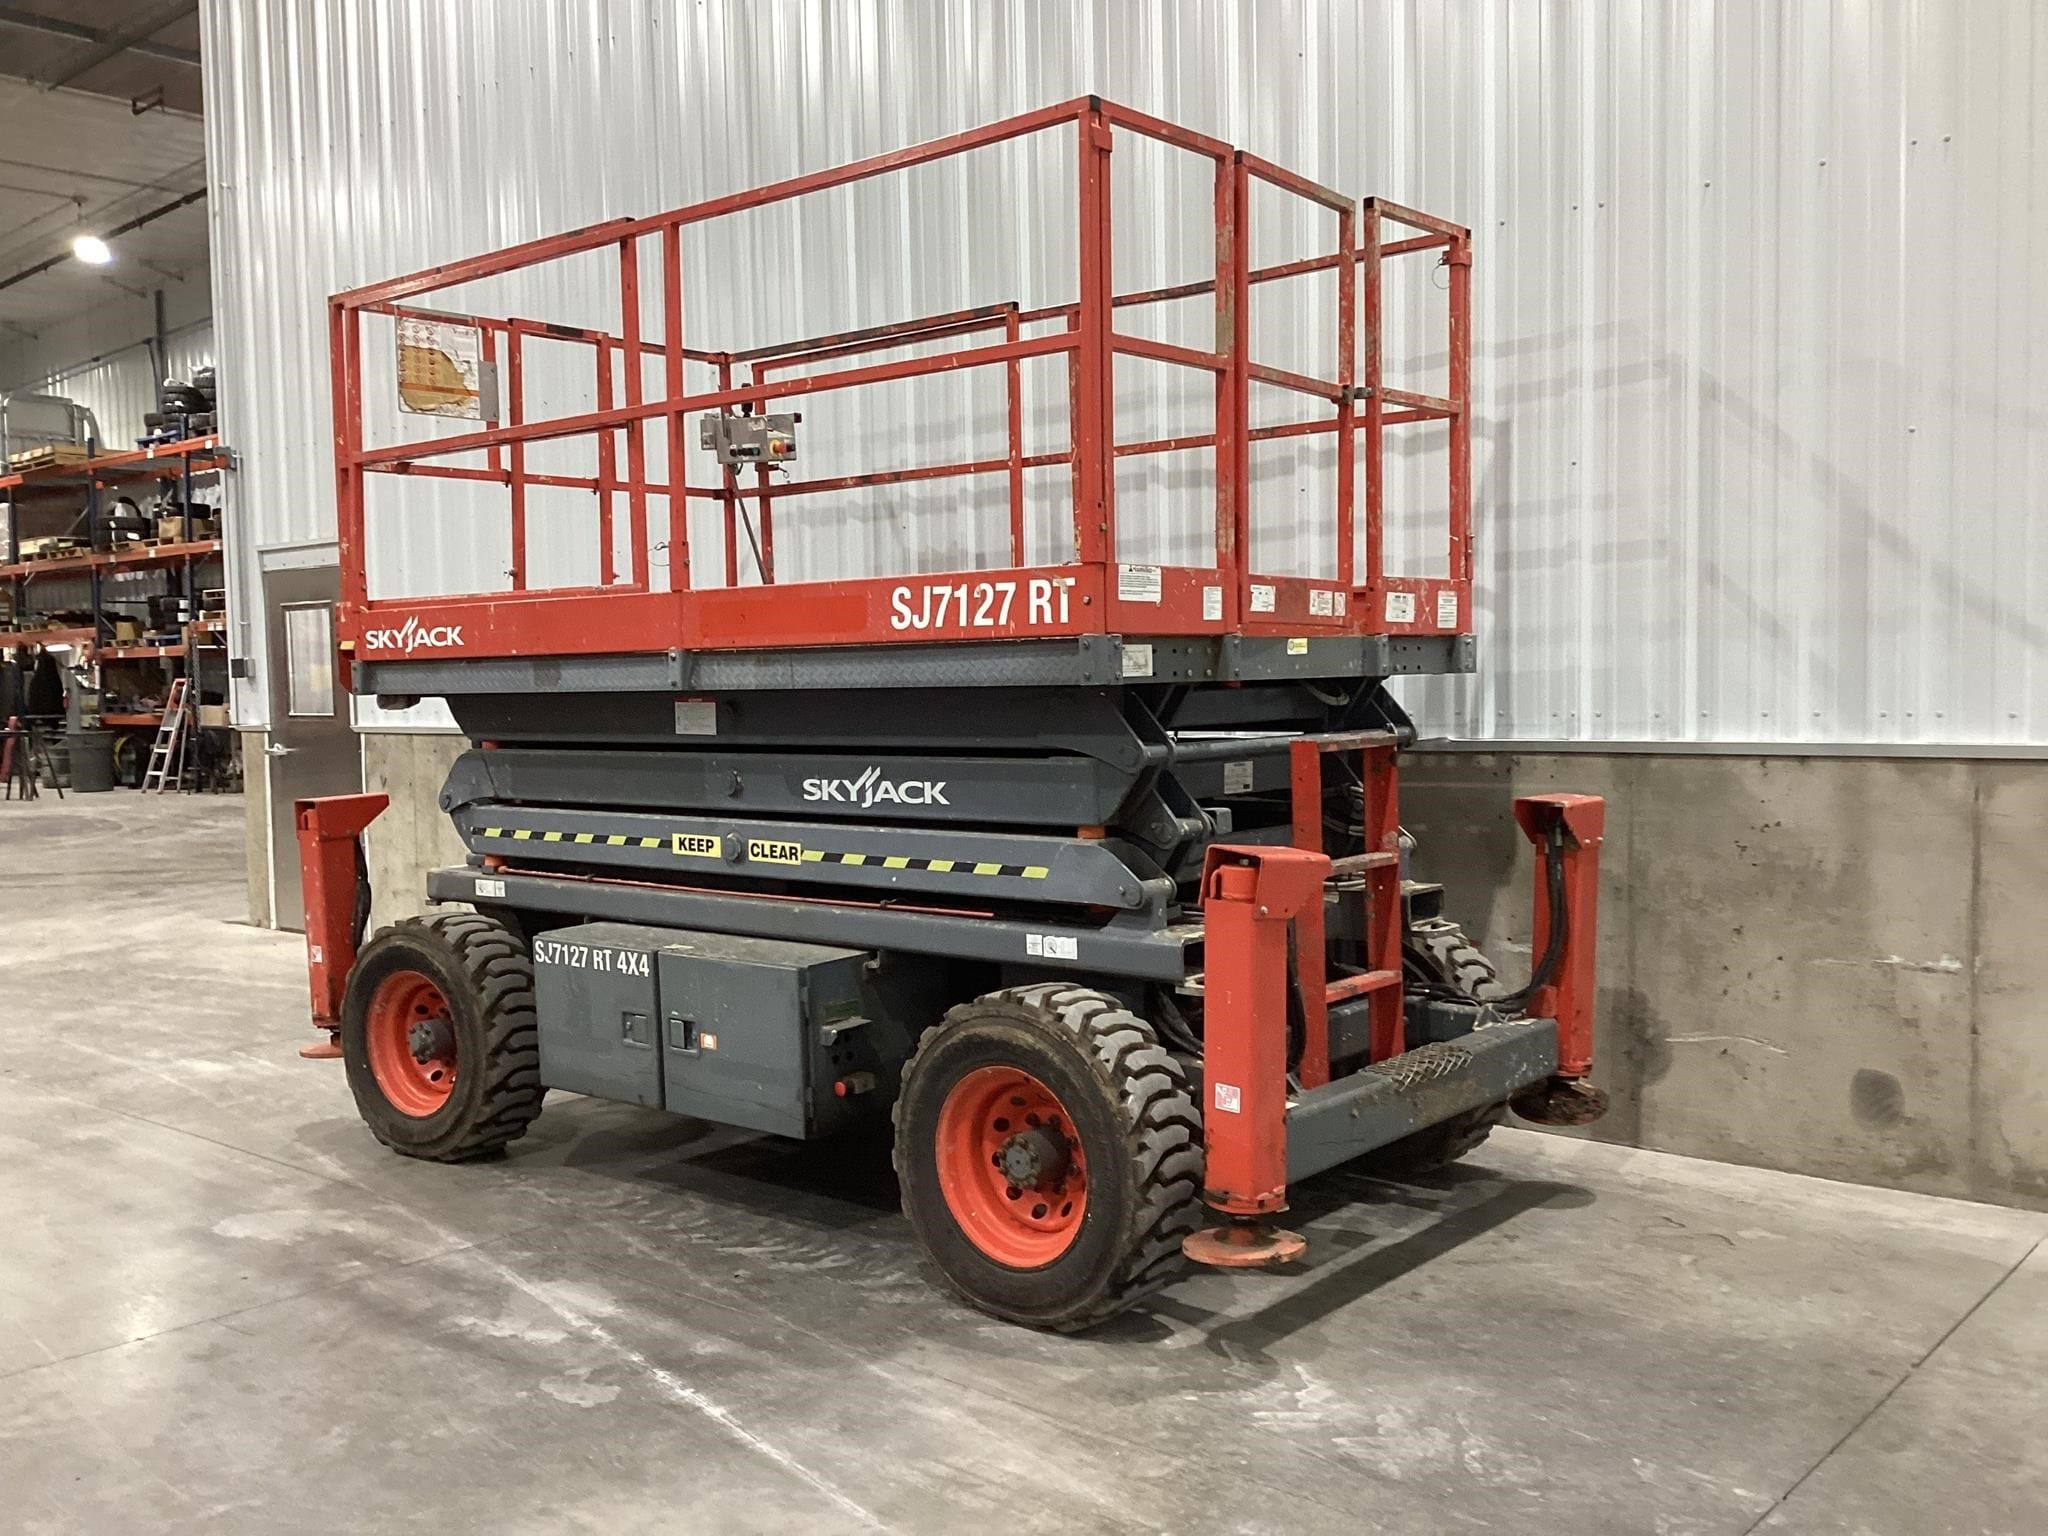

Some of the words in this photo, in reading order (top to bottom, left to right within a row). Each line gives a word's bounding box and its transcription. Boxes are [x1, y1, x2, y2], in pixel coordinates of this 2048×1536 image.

[890, 582, 1016, 631] SJ7127
[1028, 576, 1076, 625] RT
[365, 615, 465, 653] SKYJACK
[802, 765, 951, 809] SKYJACK
[678, 837, 714, 853] KEEP
[750, 843, 799, 861] CLEAR
[534, 940, 588, 968] SJ7127
[592, 949, 612, 972] RT
[617, 951, 650, 977] 4X4
